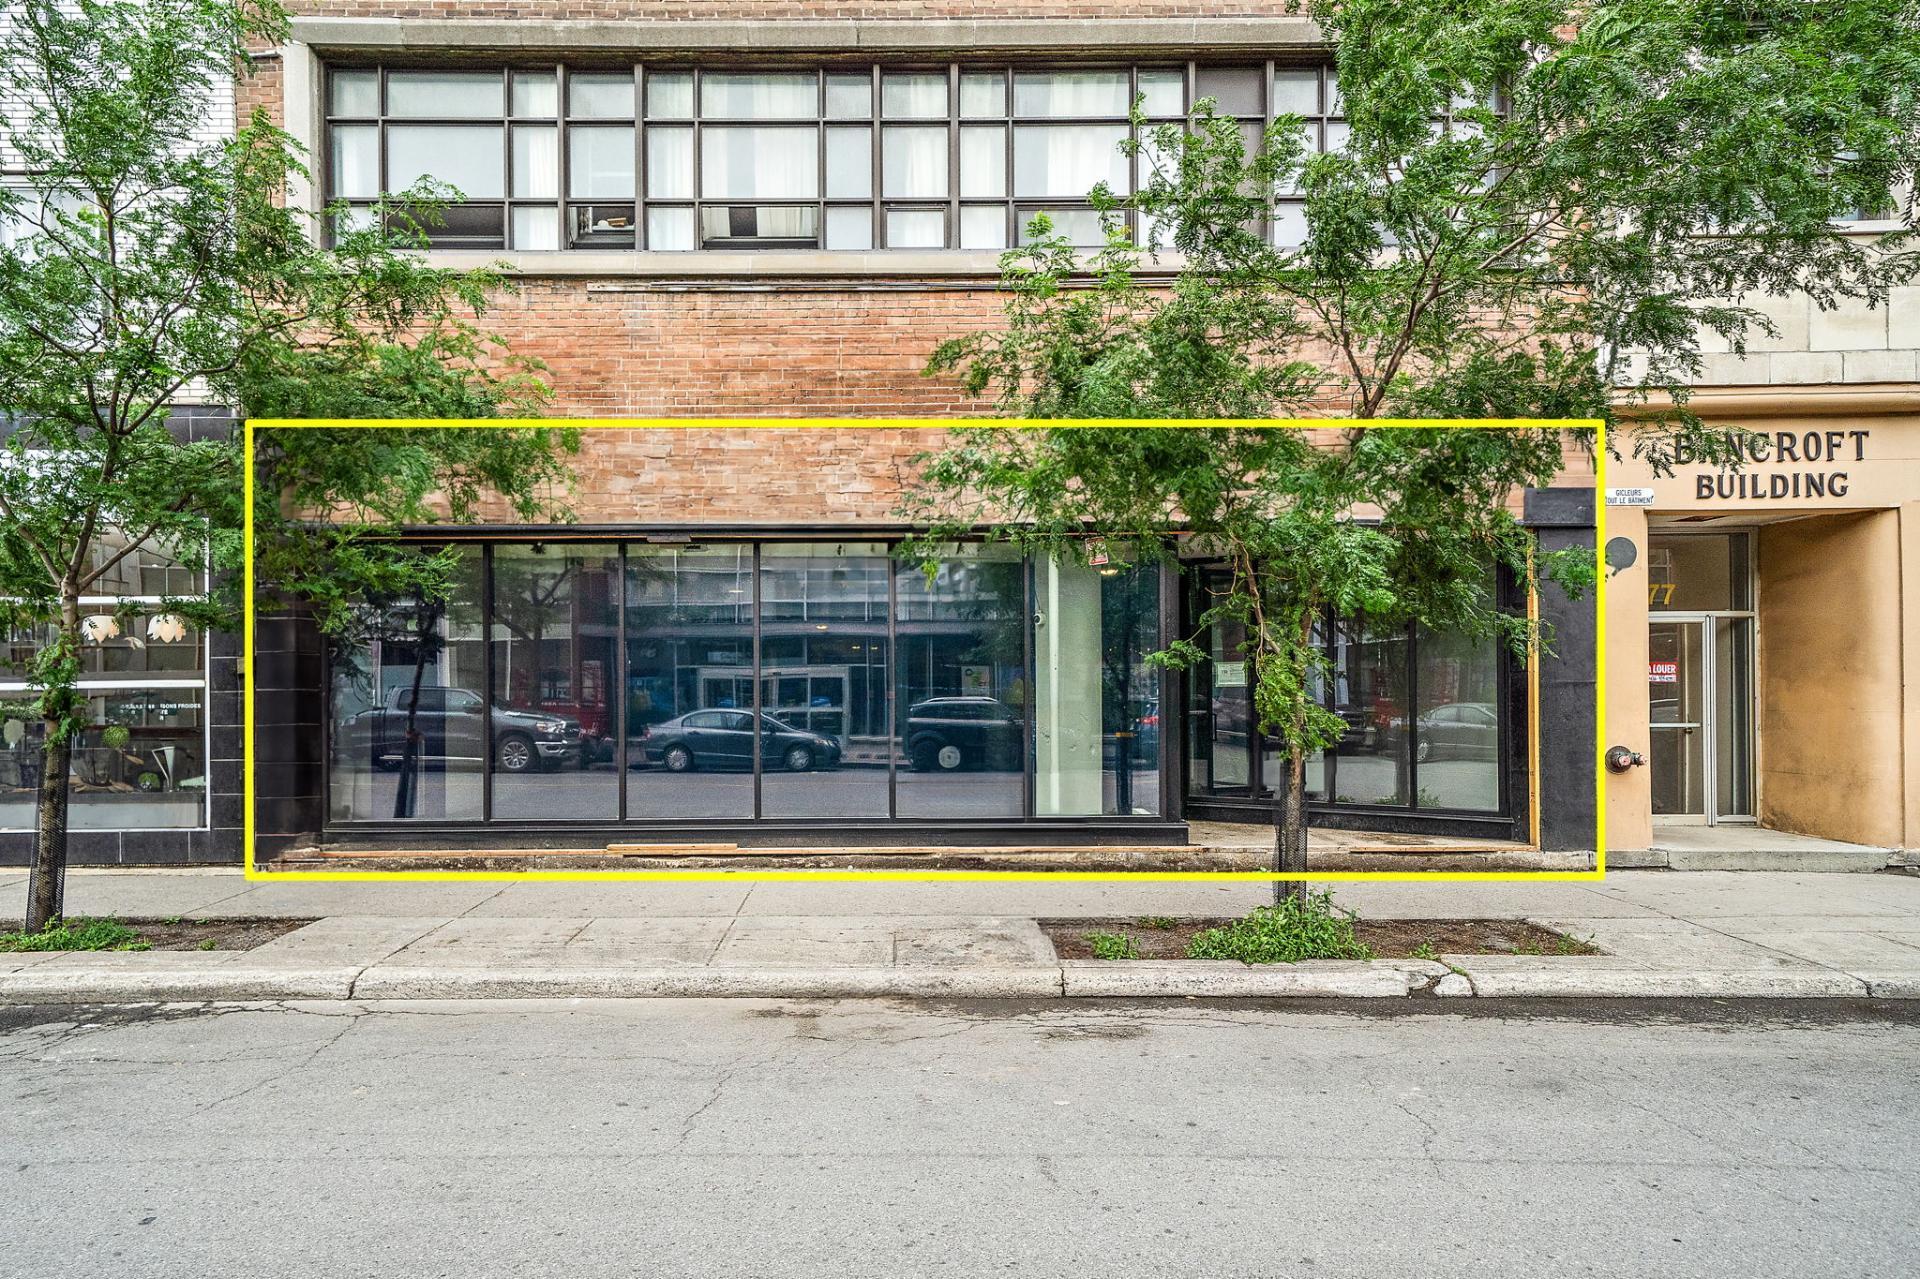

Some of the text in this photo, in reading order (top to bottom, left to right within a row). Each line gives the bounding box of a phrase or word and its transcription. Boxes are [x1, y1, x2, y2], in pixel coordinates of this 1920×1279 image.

[1674, 431, 1870, 464] BNCROFT
[1615, 489, 1642, 497] GICLEURS
[1696, 472, 1849, 499] BUILDING
[1653, 664, 1677, 674] LOUER
